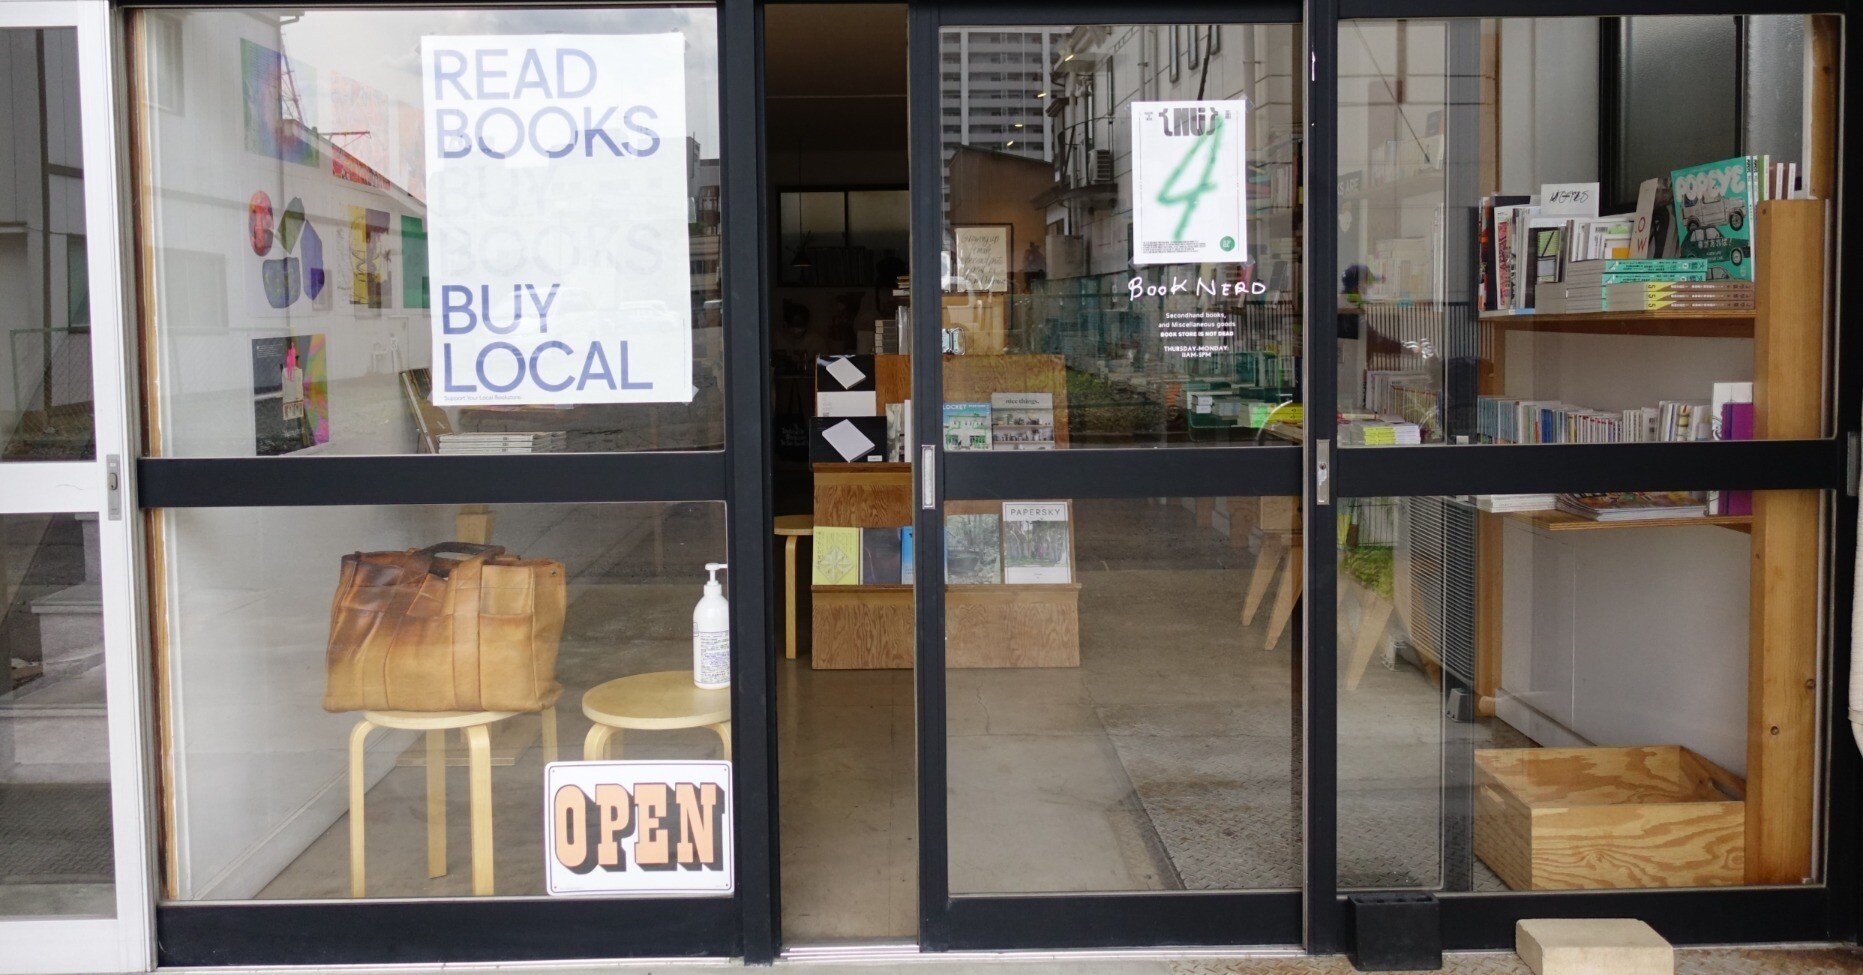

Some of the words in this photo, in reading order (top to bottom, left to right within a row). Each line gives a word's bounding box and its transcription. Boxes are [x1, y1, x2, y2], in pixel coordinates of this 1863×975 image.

[433, 48, 598, 100] READ
[437, 105, 661, 159] BOOKS
[437, 165, 560, 218] BUY
[1156, 113, 1225, 242] 4
[1674, 164, 1746, 202] POPEYE
[440, 223, 663, 277] BOOKS
[442, 283, 561, 335] BUY
[1216, 321, 1236, 329] goods
[443, 340, 653, 393] LOCAL
[1010, 508, 1061, 517] PAPERSKY
[554, 782, 725, 875] OPEN
